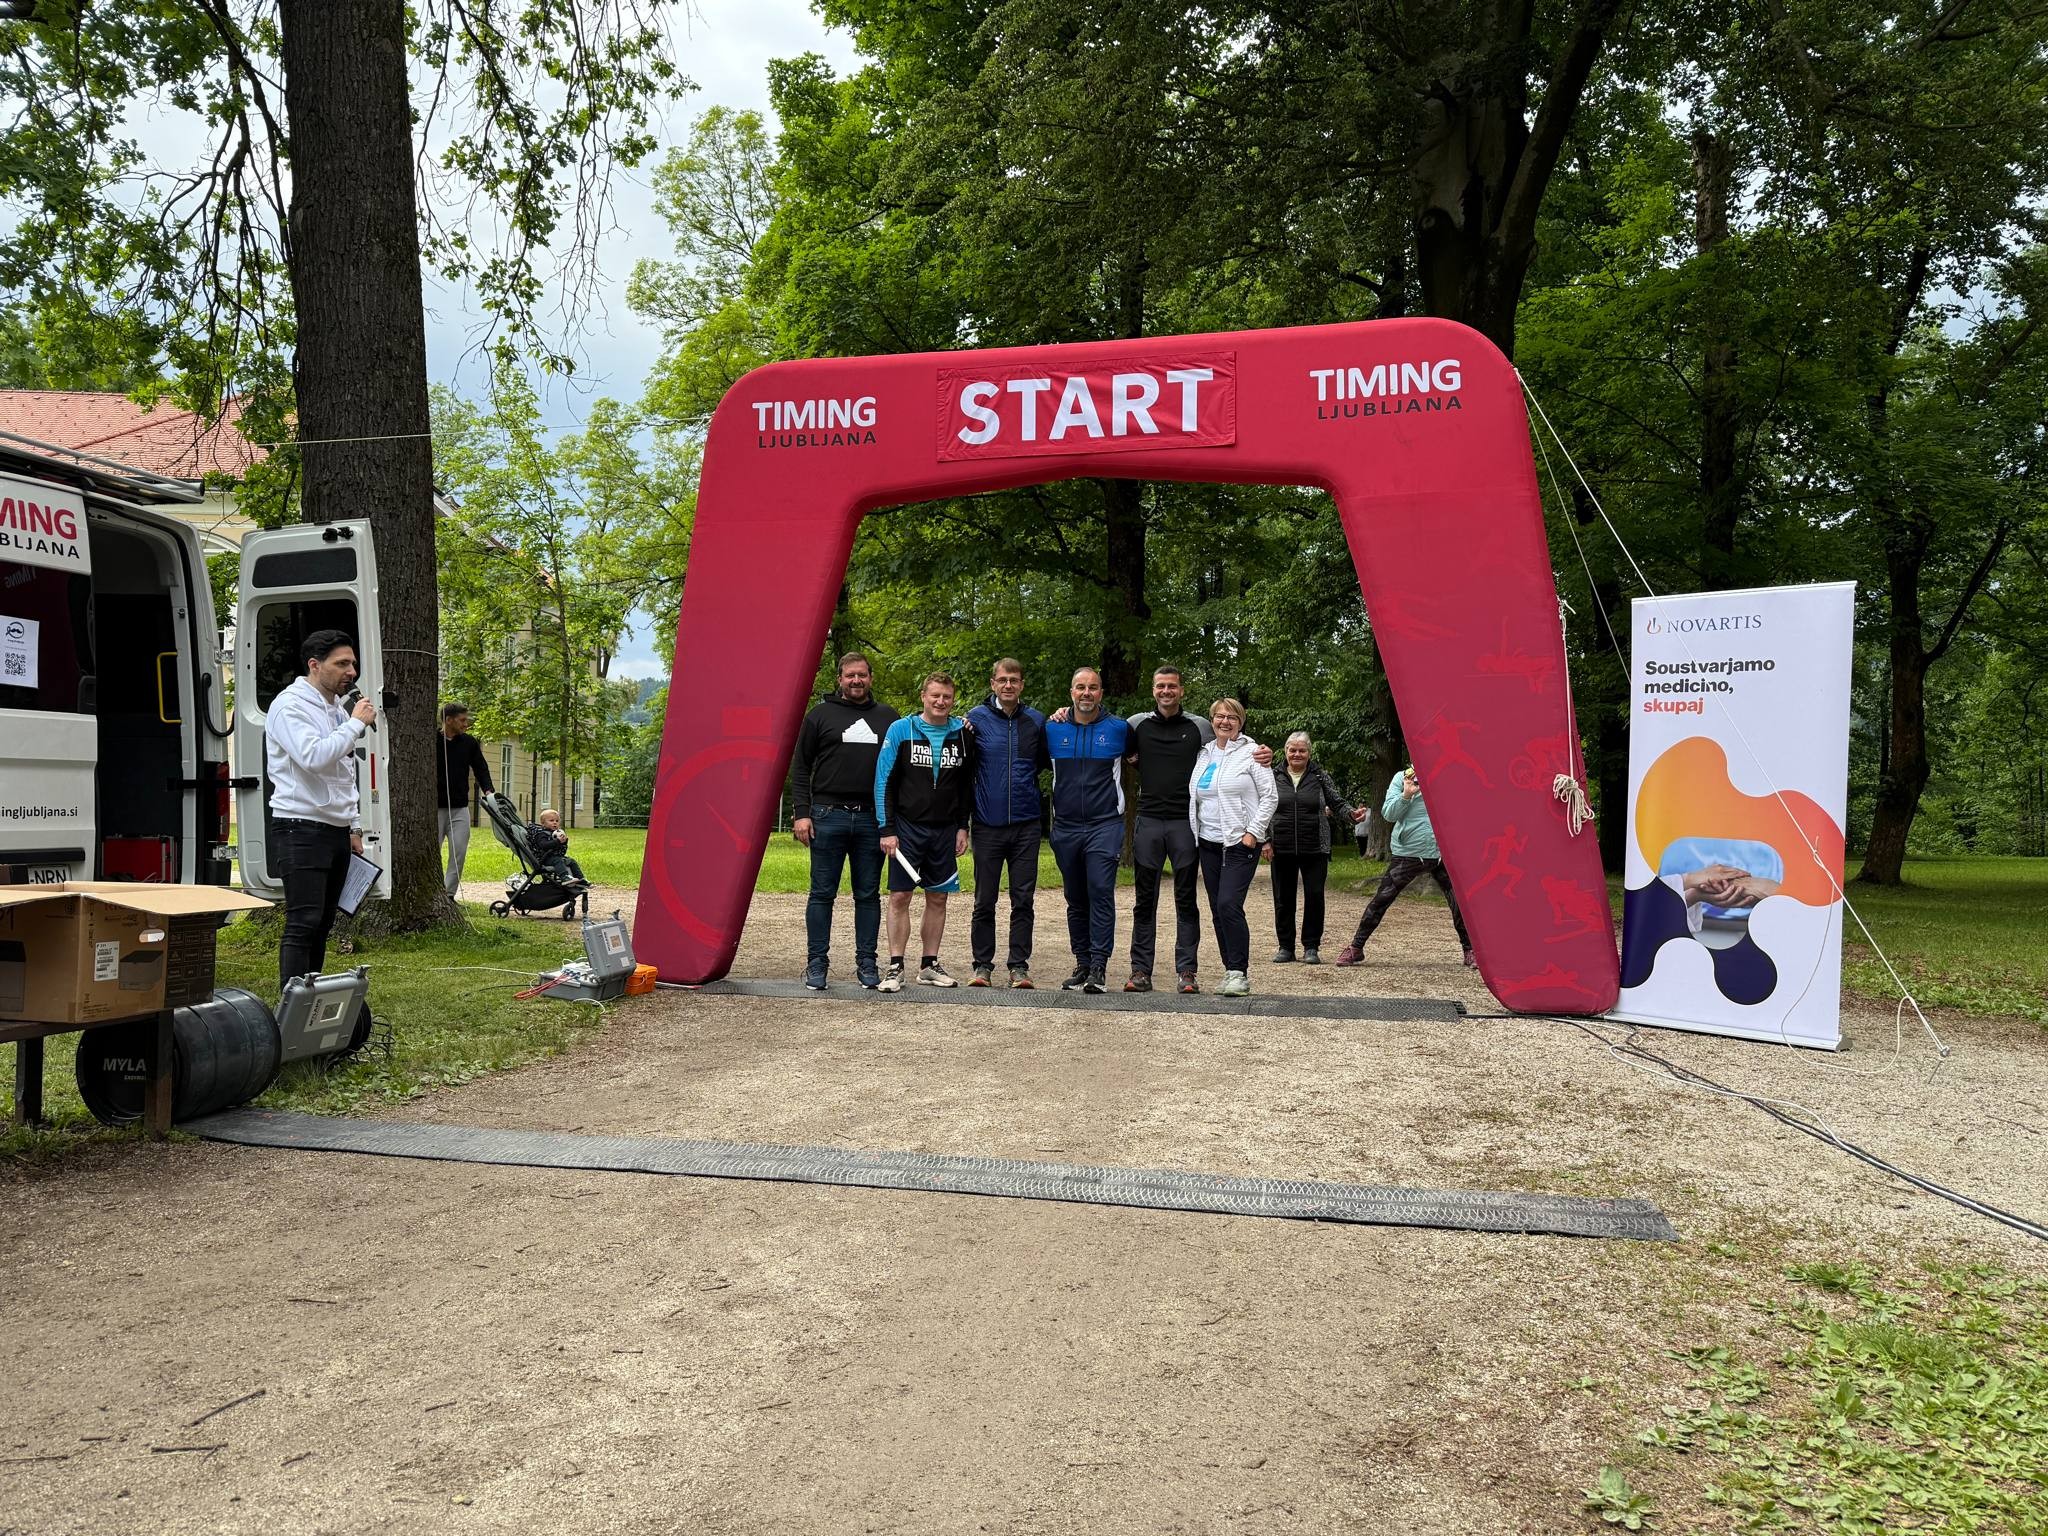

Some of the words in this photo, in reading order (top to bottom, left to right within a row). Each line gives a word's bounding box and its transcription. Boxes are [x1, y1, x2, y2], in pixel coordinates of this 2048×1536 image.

[1309, 359, 1462, 401] TIMING
[752, 396, 877, 431] TIMING
[957, 367, 1214, 446] START
[1318, 396, 1463, 420] LJUBLJANA
[758, 431, 877, 449] LJUBLJANA
[1667, 614, 1762, 634] NOVARTIS
[1645, 657, 1776, 676] Soustvarjamo
[1644, 678, 1734, 695] medicino,
[1643, 696, 1704, 715] skupaj
[951, 743, 959, 757] it
